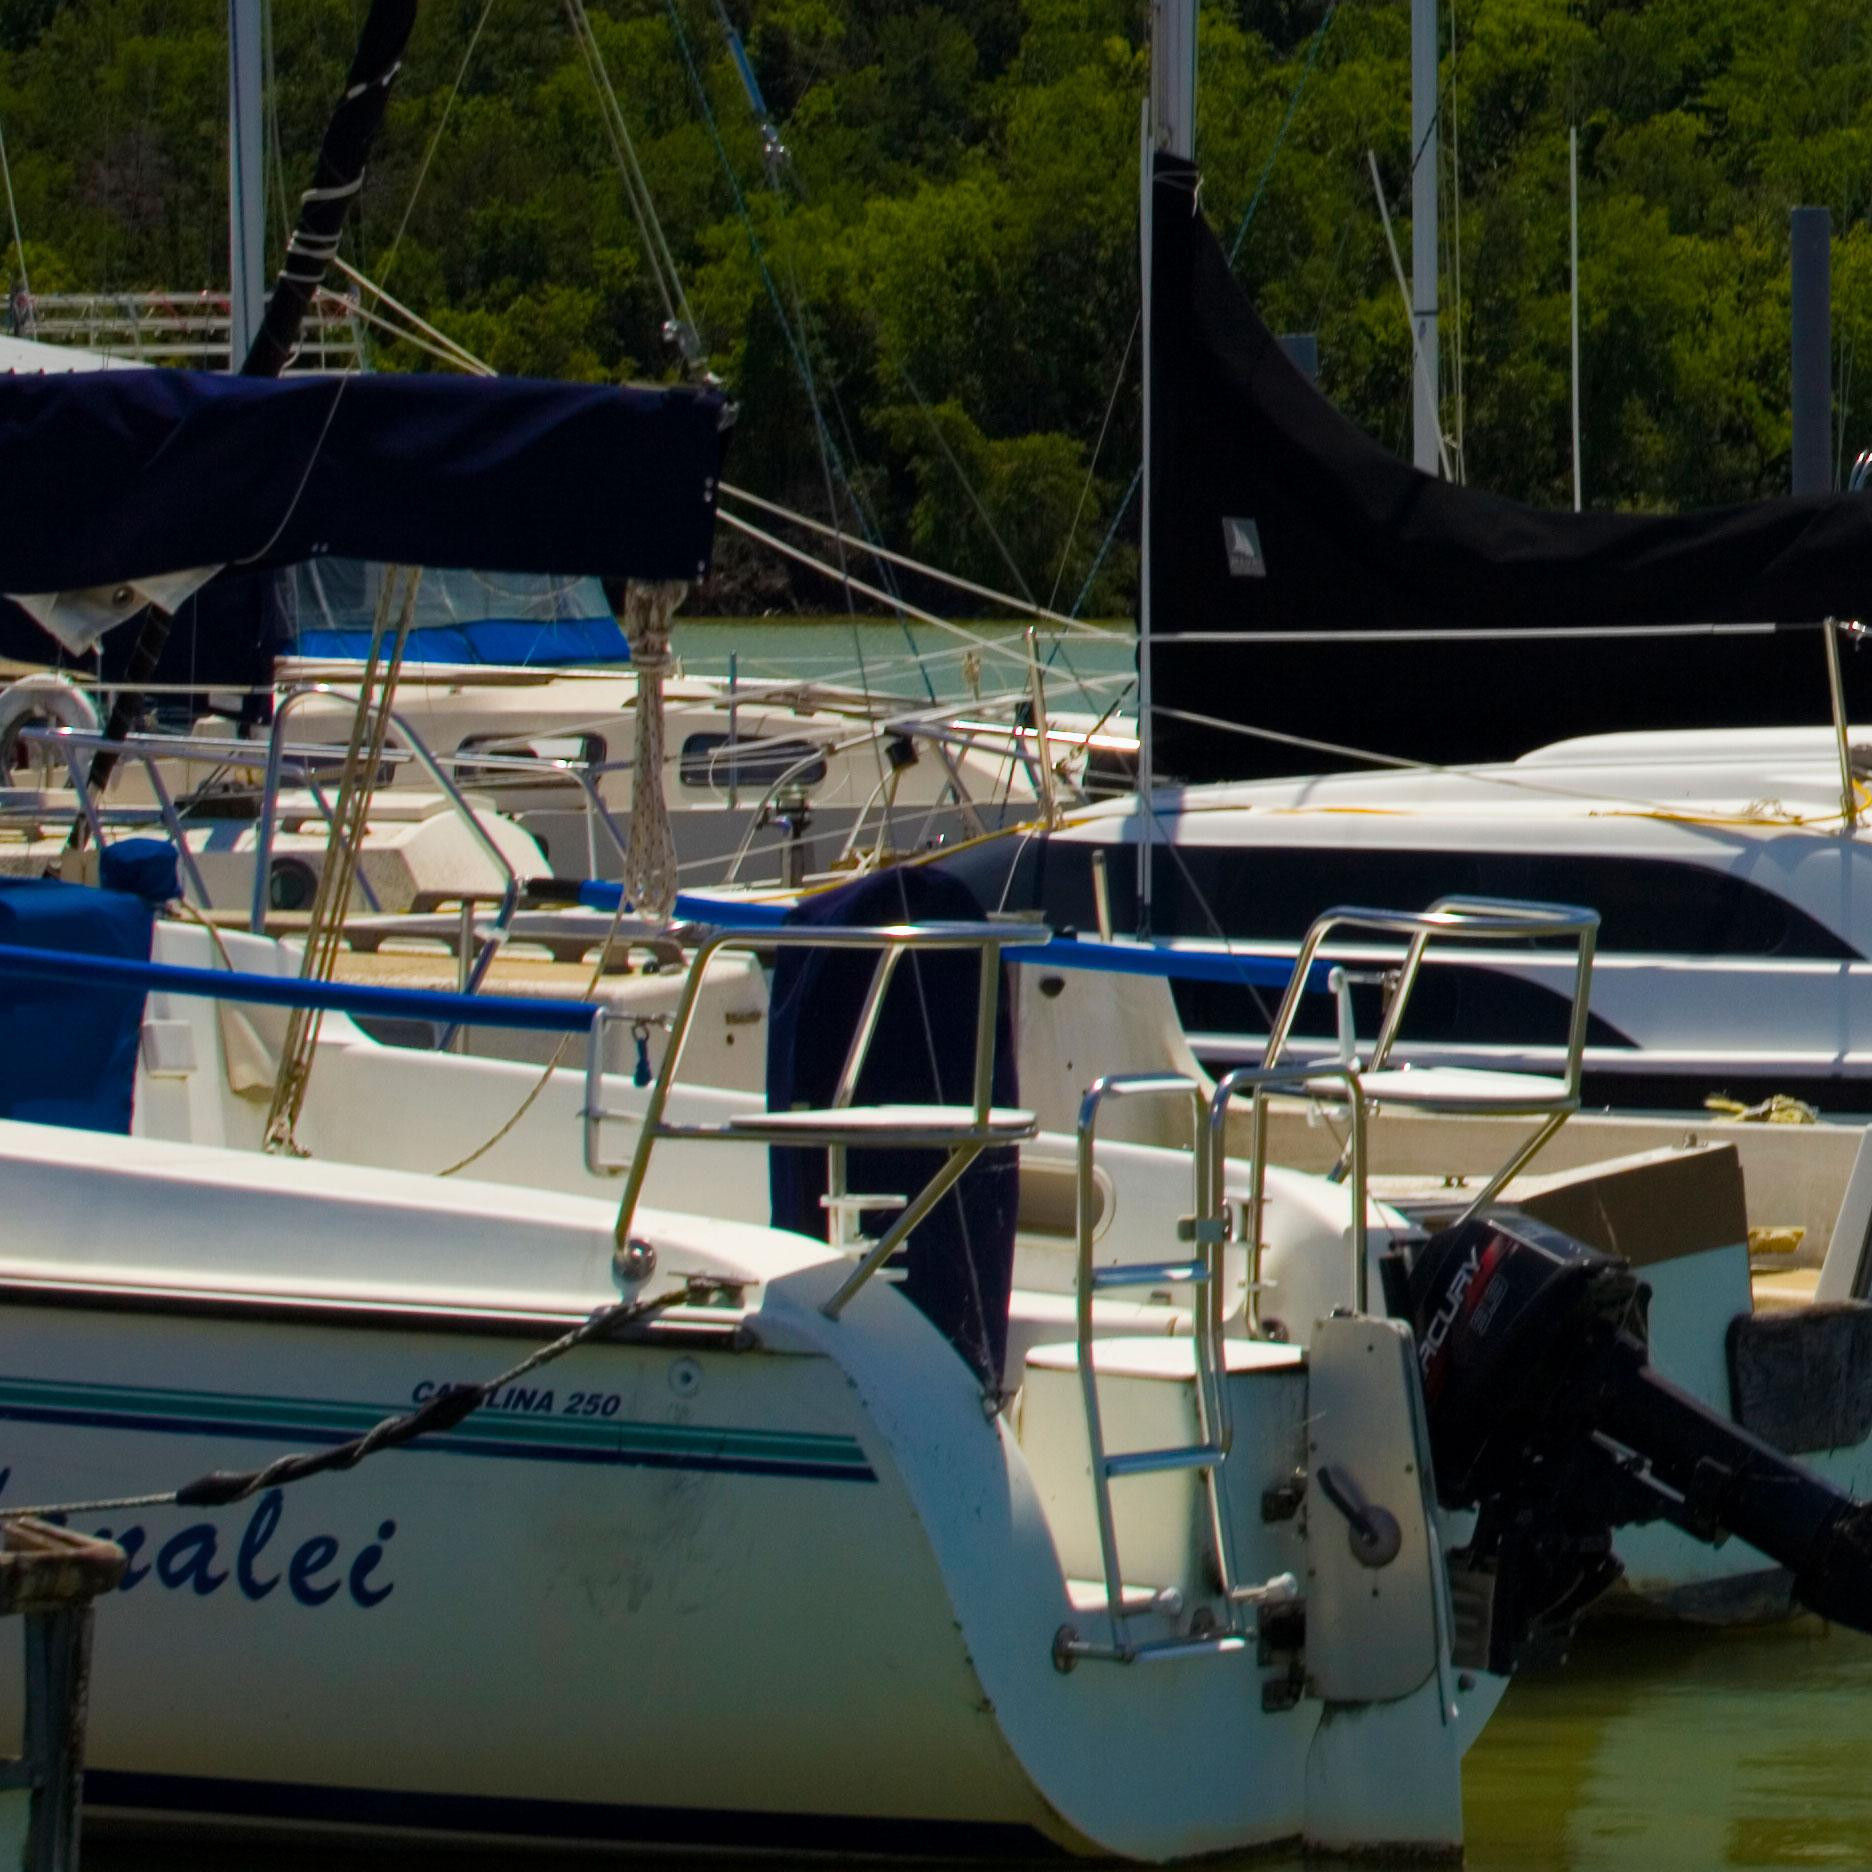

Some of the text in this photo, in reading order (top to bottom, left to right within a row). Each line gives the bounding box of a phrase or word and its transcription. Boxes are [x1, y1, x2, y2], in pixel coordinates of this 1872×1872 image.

[1418, 1244, 1480, 1376] RCURY
[412, 1380, 622, 1417] CALINA 250
